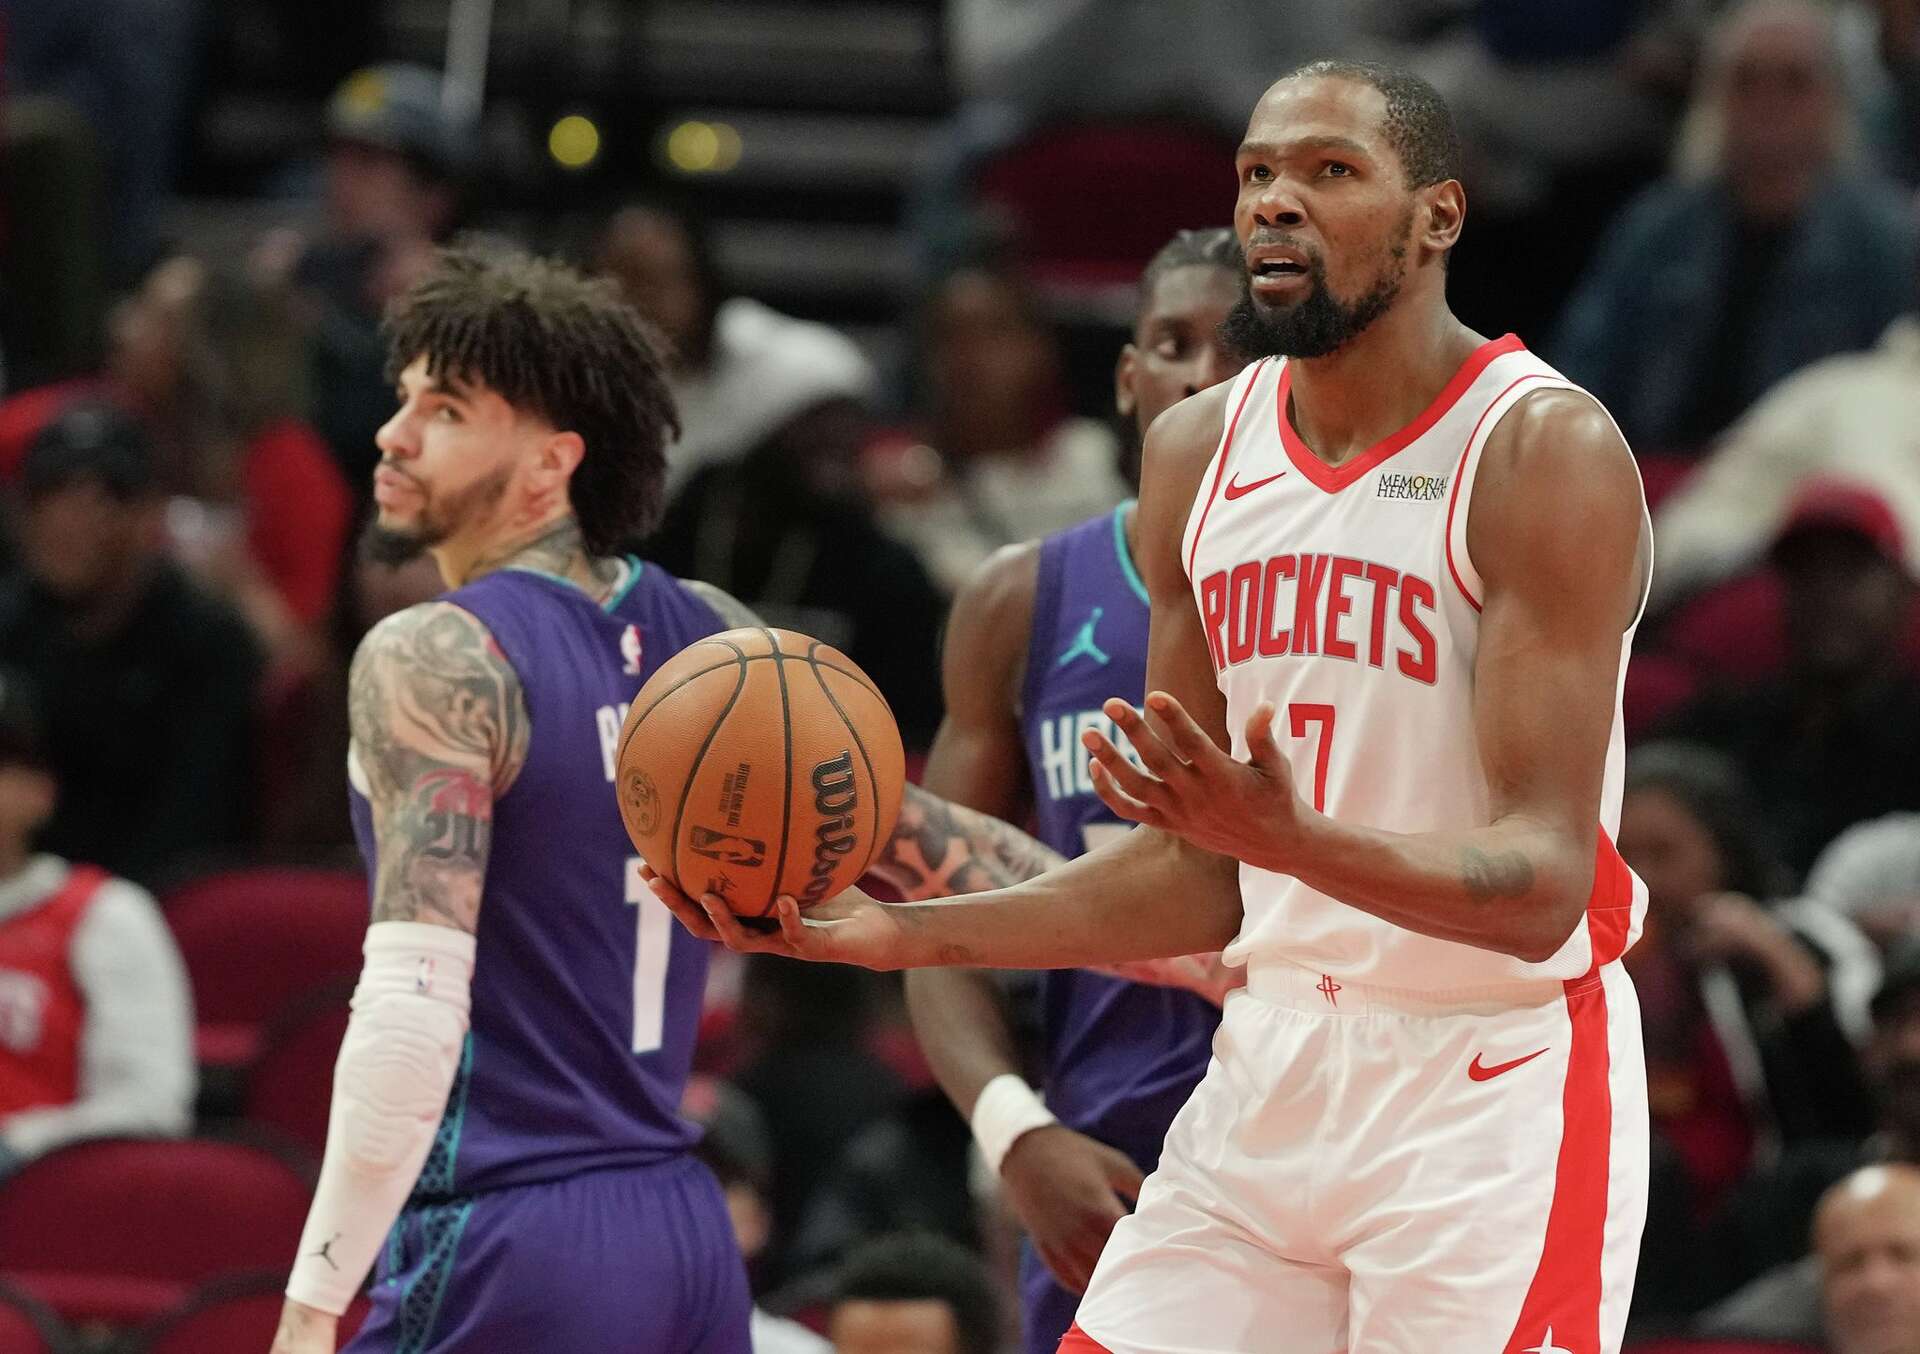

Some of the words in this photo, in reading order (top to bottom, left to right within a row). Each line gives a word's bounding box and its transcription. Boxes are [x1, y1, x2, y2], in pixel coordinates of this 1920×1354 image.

[1377, 484, 1446, 501] HERMANN
[1199, 552, 1438, 687] ROCKETS
[1288, 703, 1336, 814] 7
[624, 857, 673, 1054] 1
